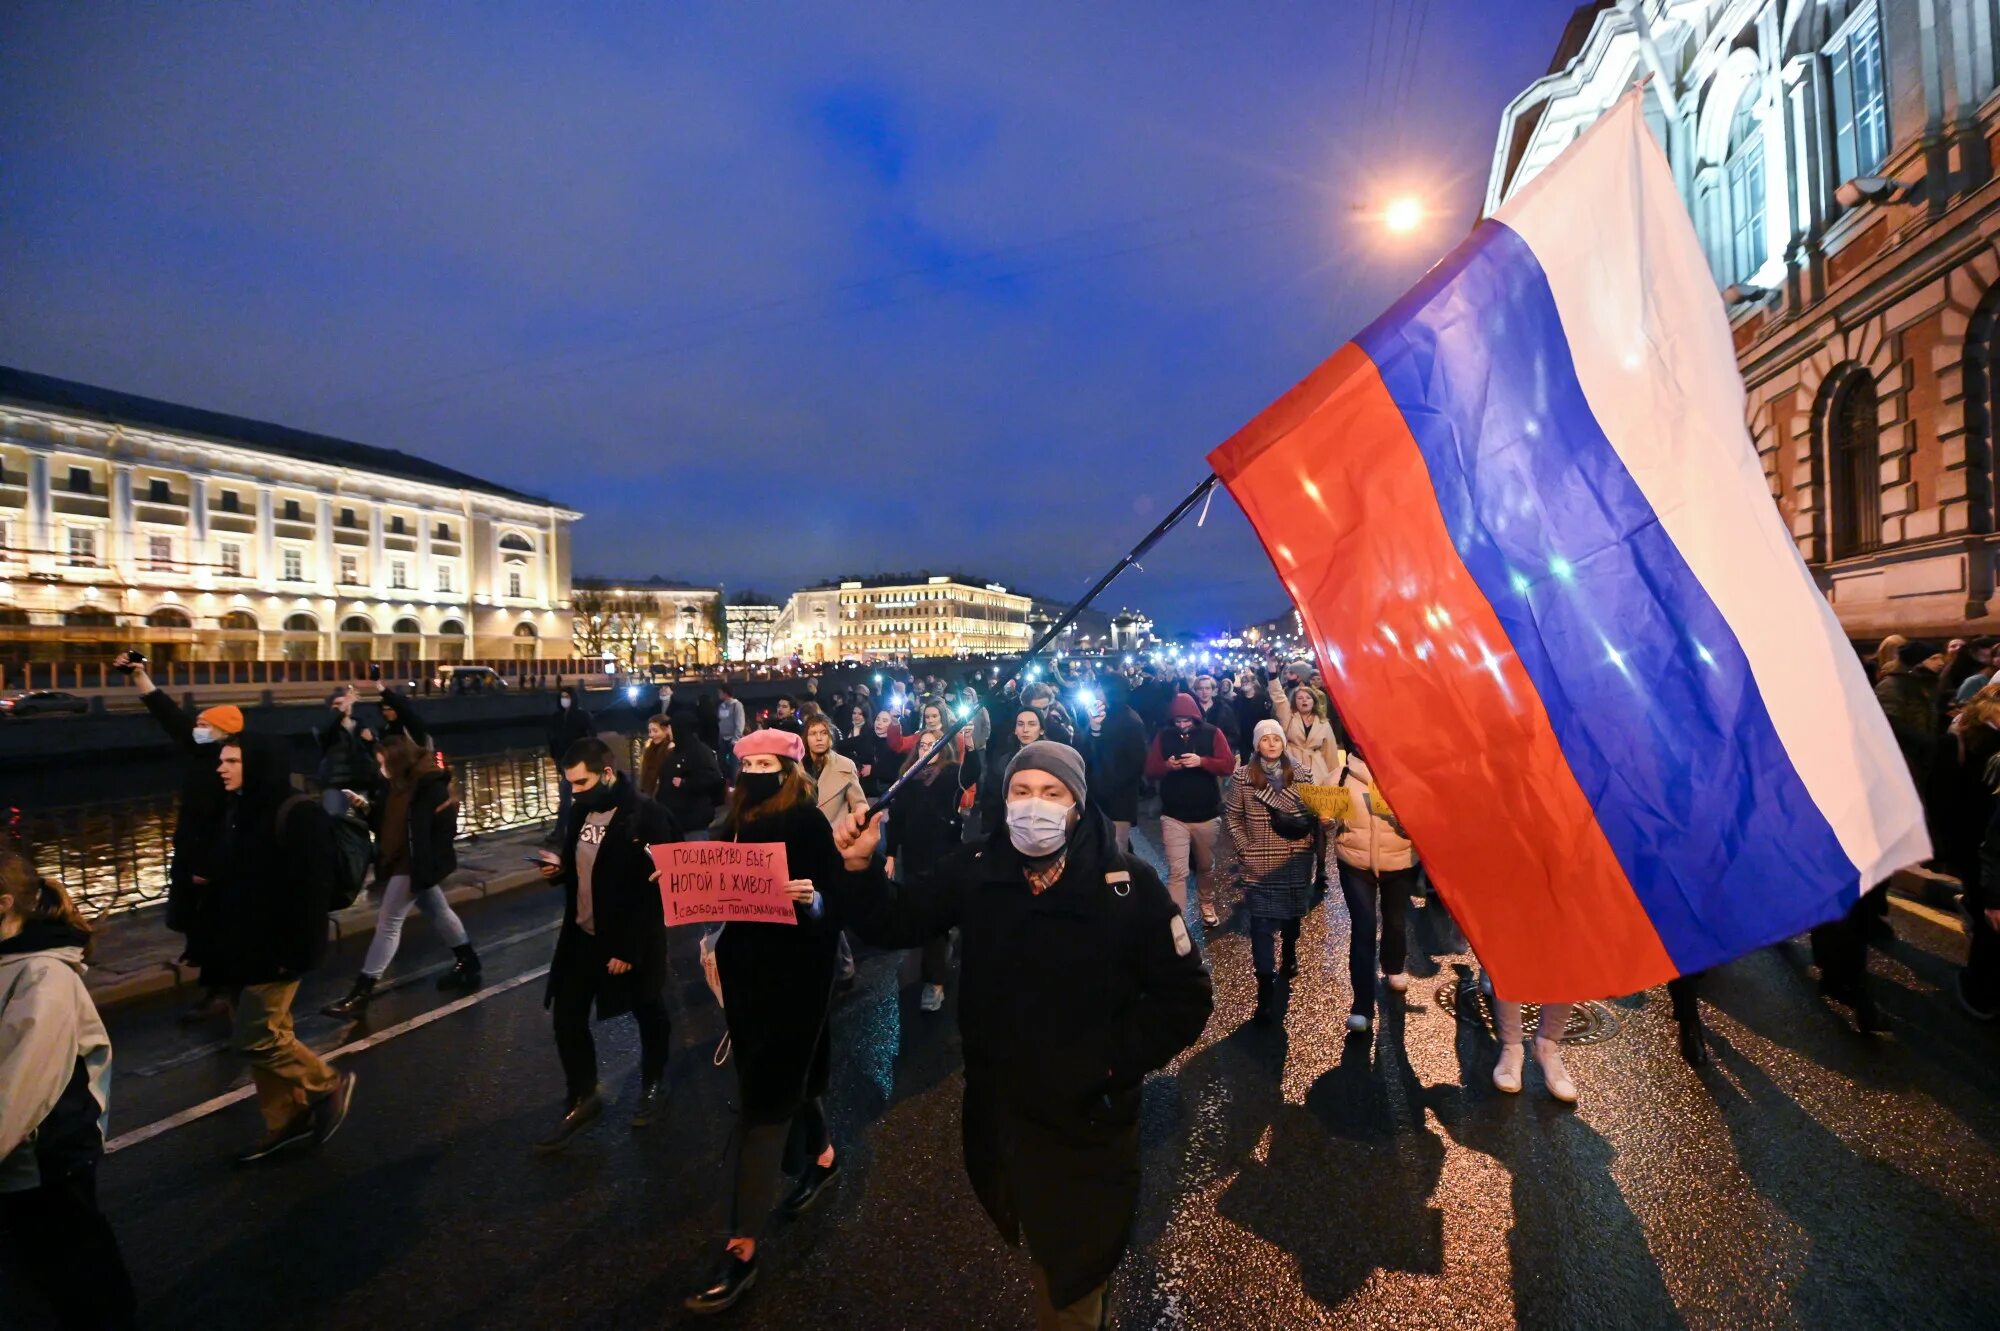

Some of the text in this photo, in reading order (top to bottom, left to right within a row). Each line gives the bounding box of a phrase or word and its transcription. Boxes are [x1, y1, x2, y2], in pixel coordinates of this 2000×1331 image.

[673, 847, 774, 869] ГОСУДАРСТВО БЬЁТ
[671, 871, 713, 894] НОГОЙ
[719, 873, 726, 891] В
